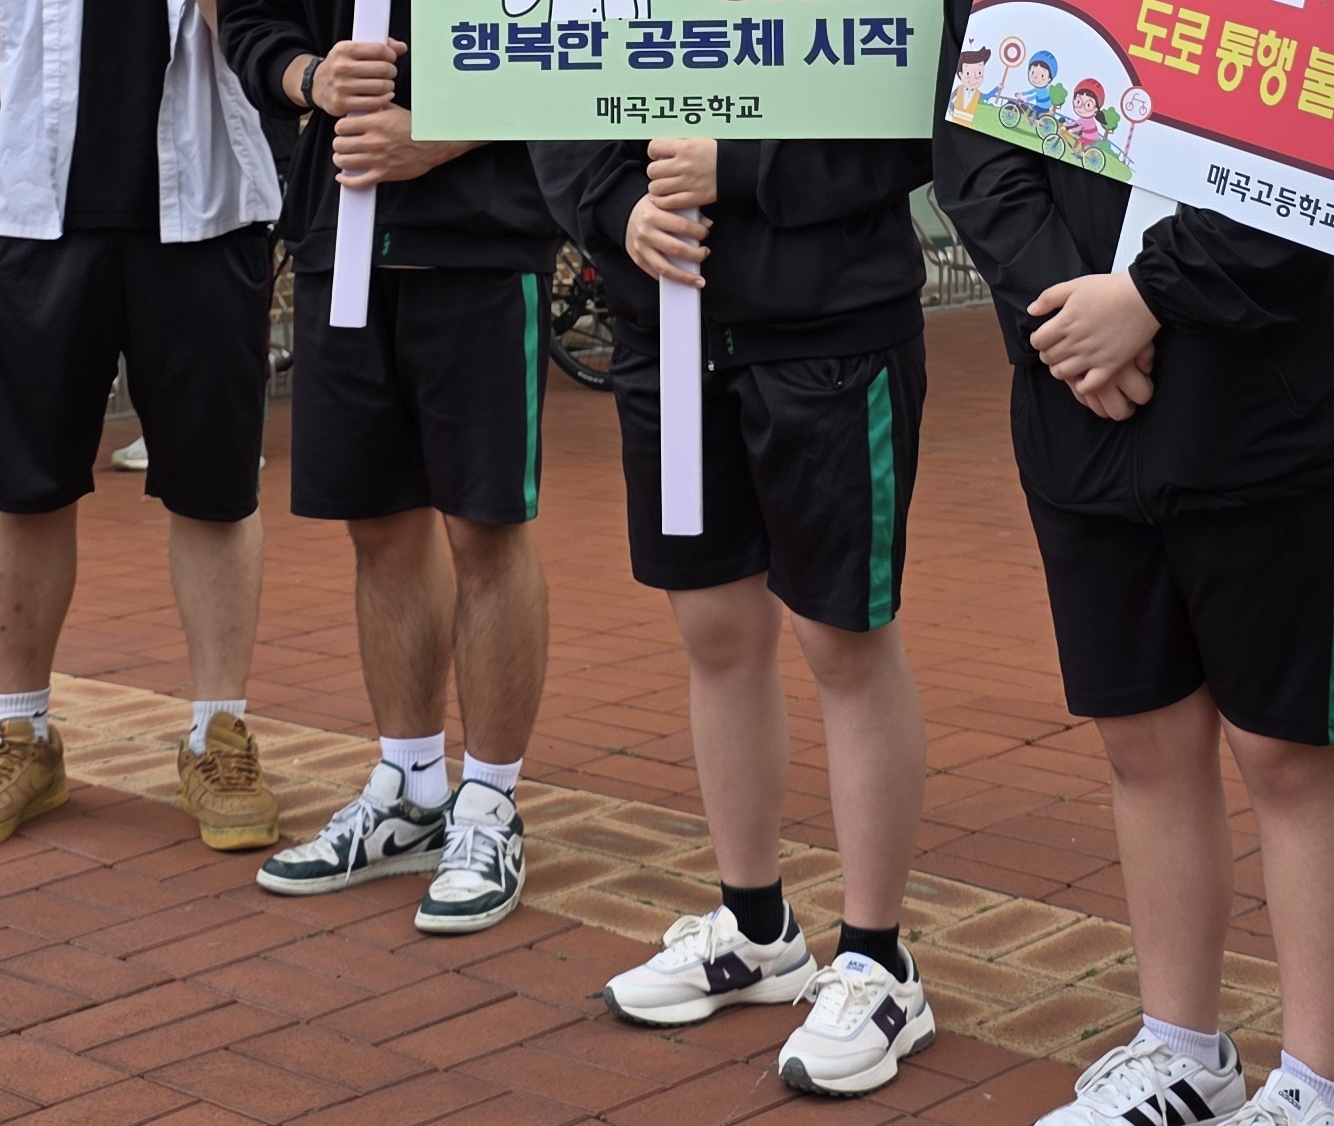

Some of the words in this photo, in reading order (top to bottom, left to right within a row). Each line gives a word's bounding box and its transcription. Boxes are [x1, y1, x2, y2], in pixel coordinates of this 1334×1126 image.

[451, 20, 609, 72] 행복한
[625, 17, 784, 70] 공동체
[803, 17, 915, 68] 시작
[1216, 20, 1298, 106] 통행
[596, 96, 764, 125] 매곡고등학교
